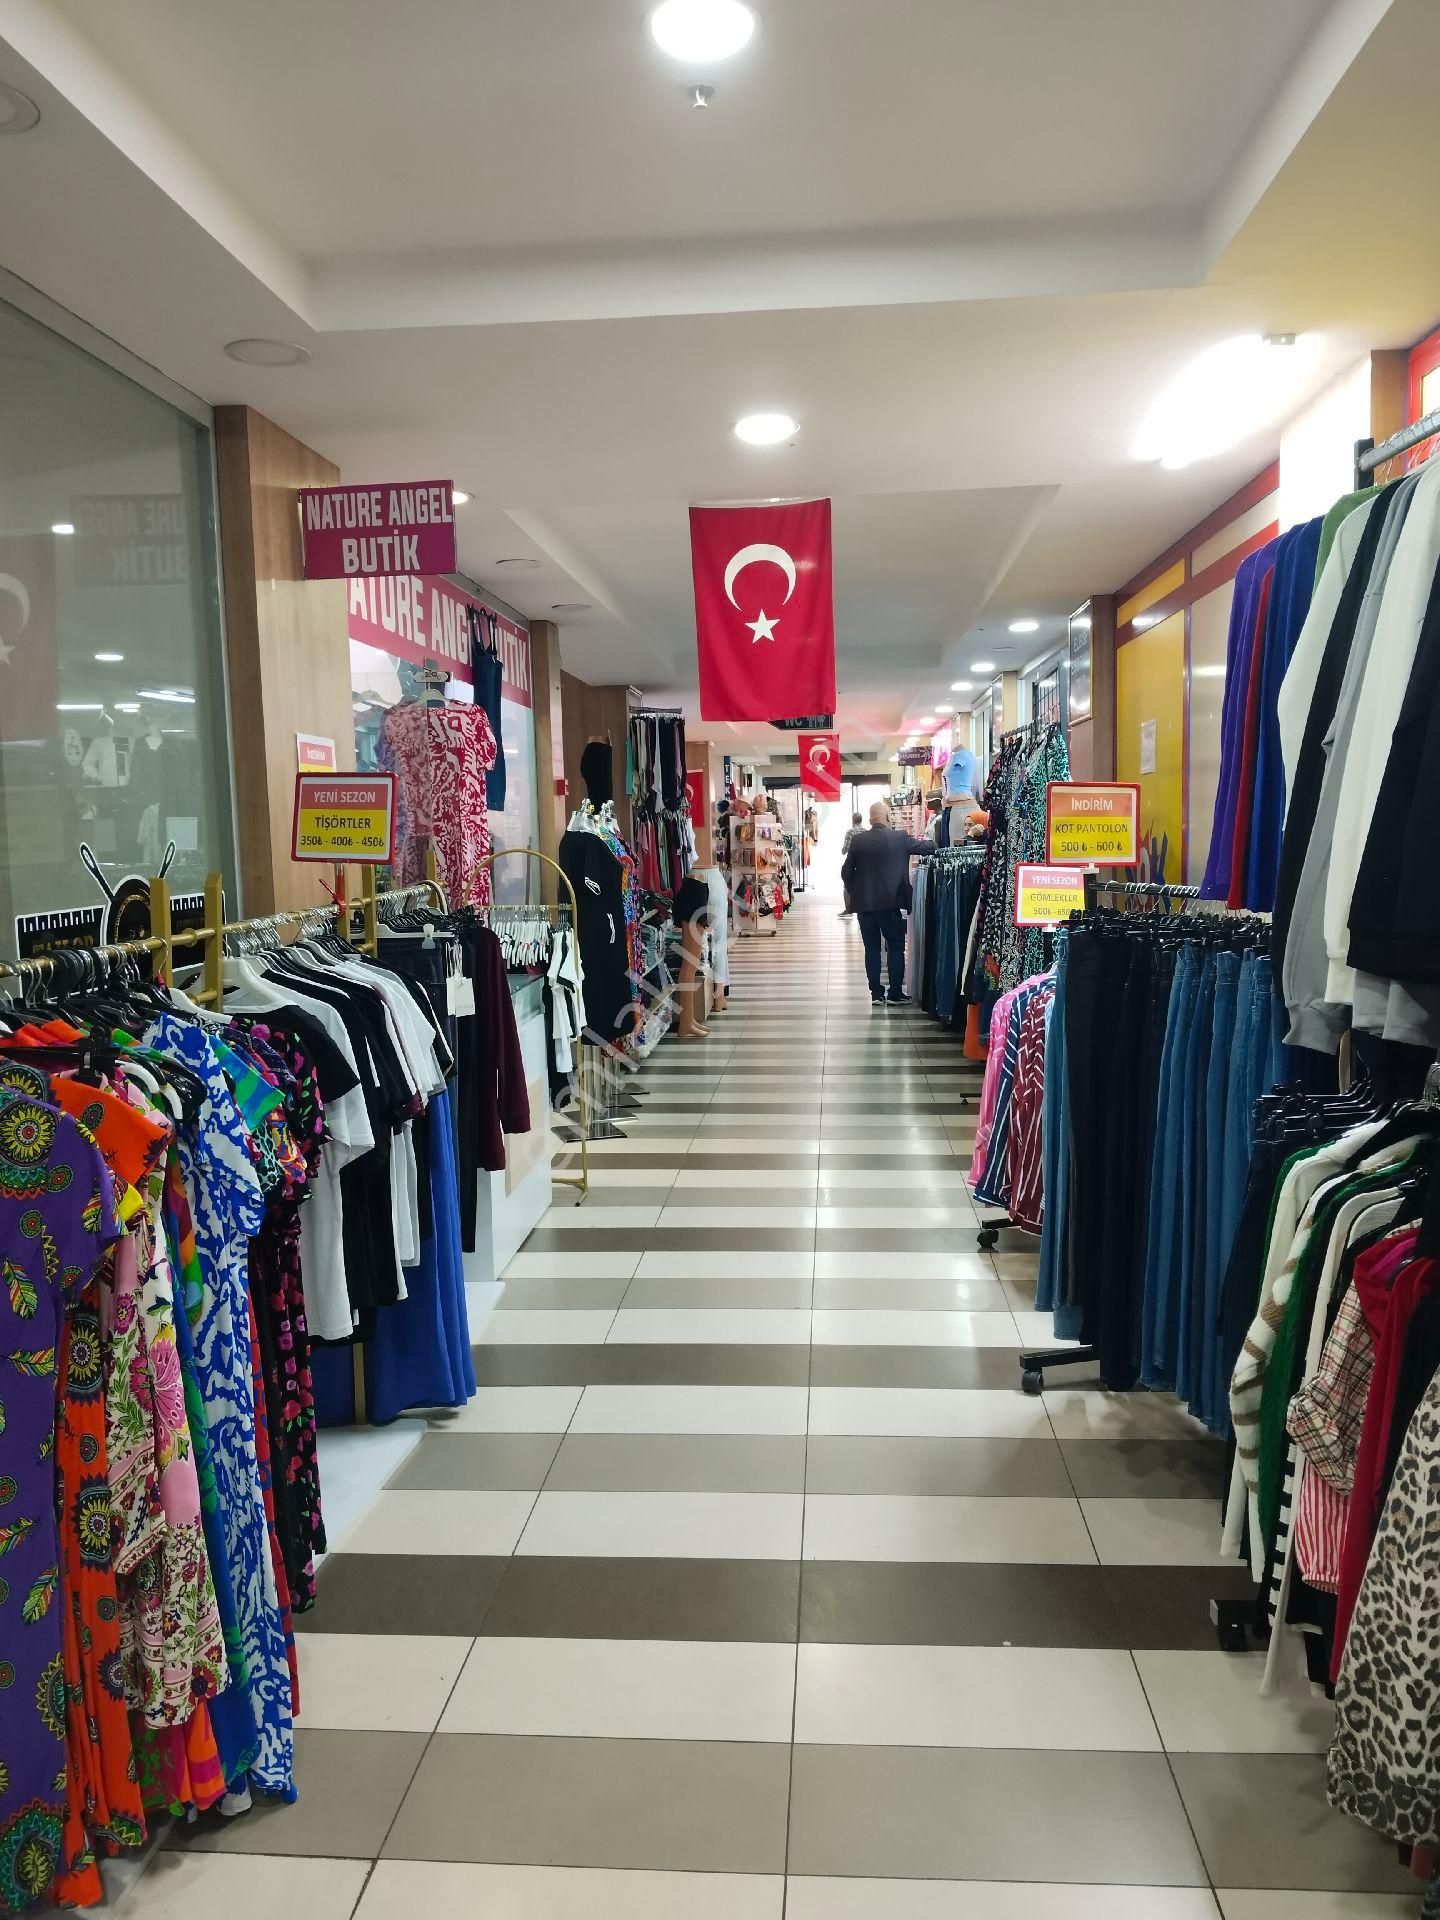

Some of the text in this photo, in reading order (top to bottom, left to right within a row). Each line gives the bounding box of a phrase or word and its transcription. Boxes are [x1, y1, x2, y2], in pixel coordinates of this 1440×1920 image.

[306, 487, 454, 530] NATURE ANGEL
[342, 529, 420, 574] BUTİK
[314, 788, 376, 803] YENİ SEZON
[1071, 797, 1113, 811] İNDİRİM
[314, 814, 371, 831] TİŞÖRTLER
[1055, 823, 1128, 833] KOT PANTOLON
[1061, 841, 1079, 852] 500
[1096, 841, 1115, 852] 600
[1032, 875, 1078, 885] YENİ SEZON
[1030, 892, 1078, 902] GÖMLEKLER
